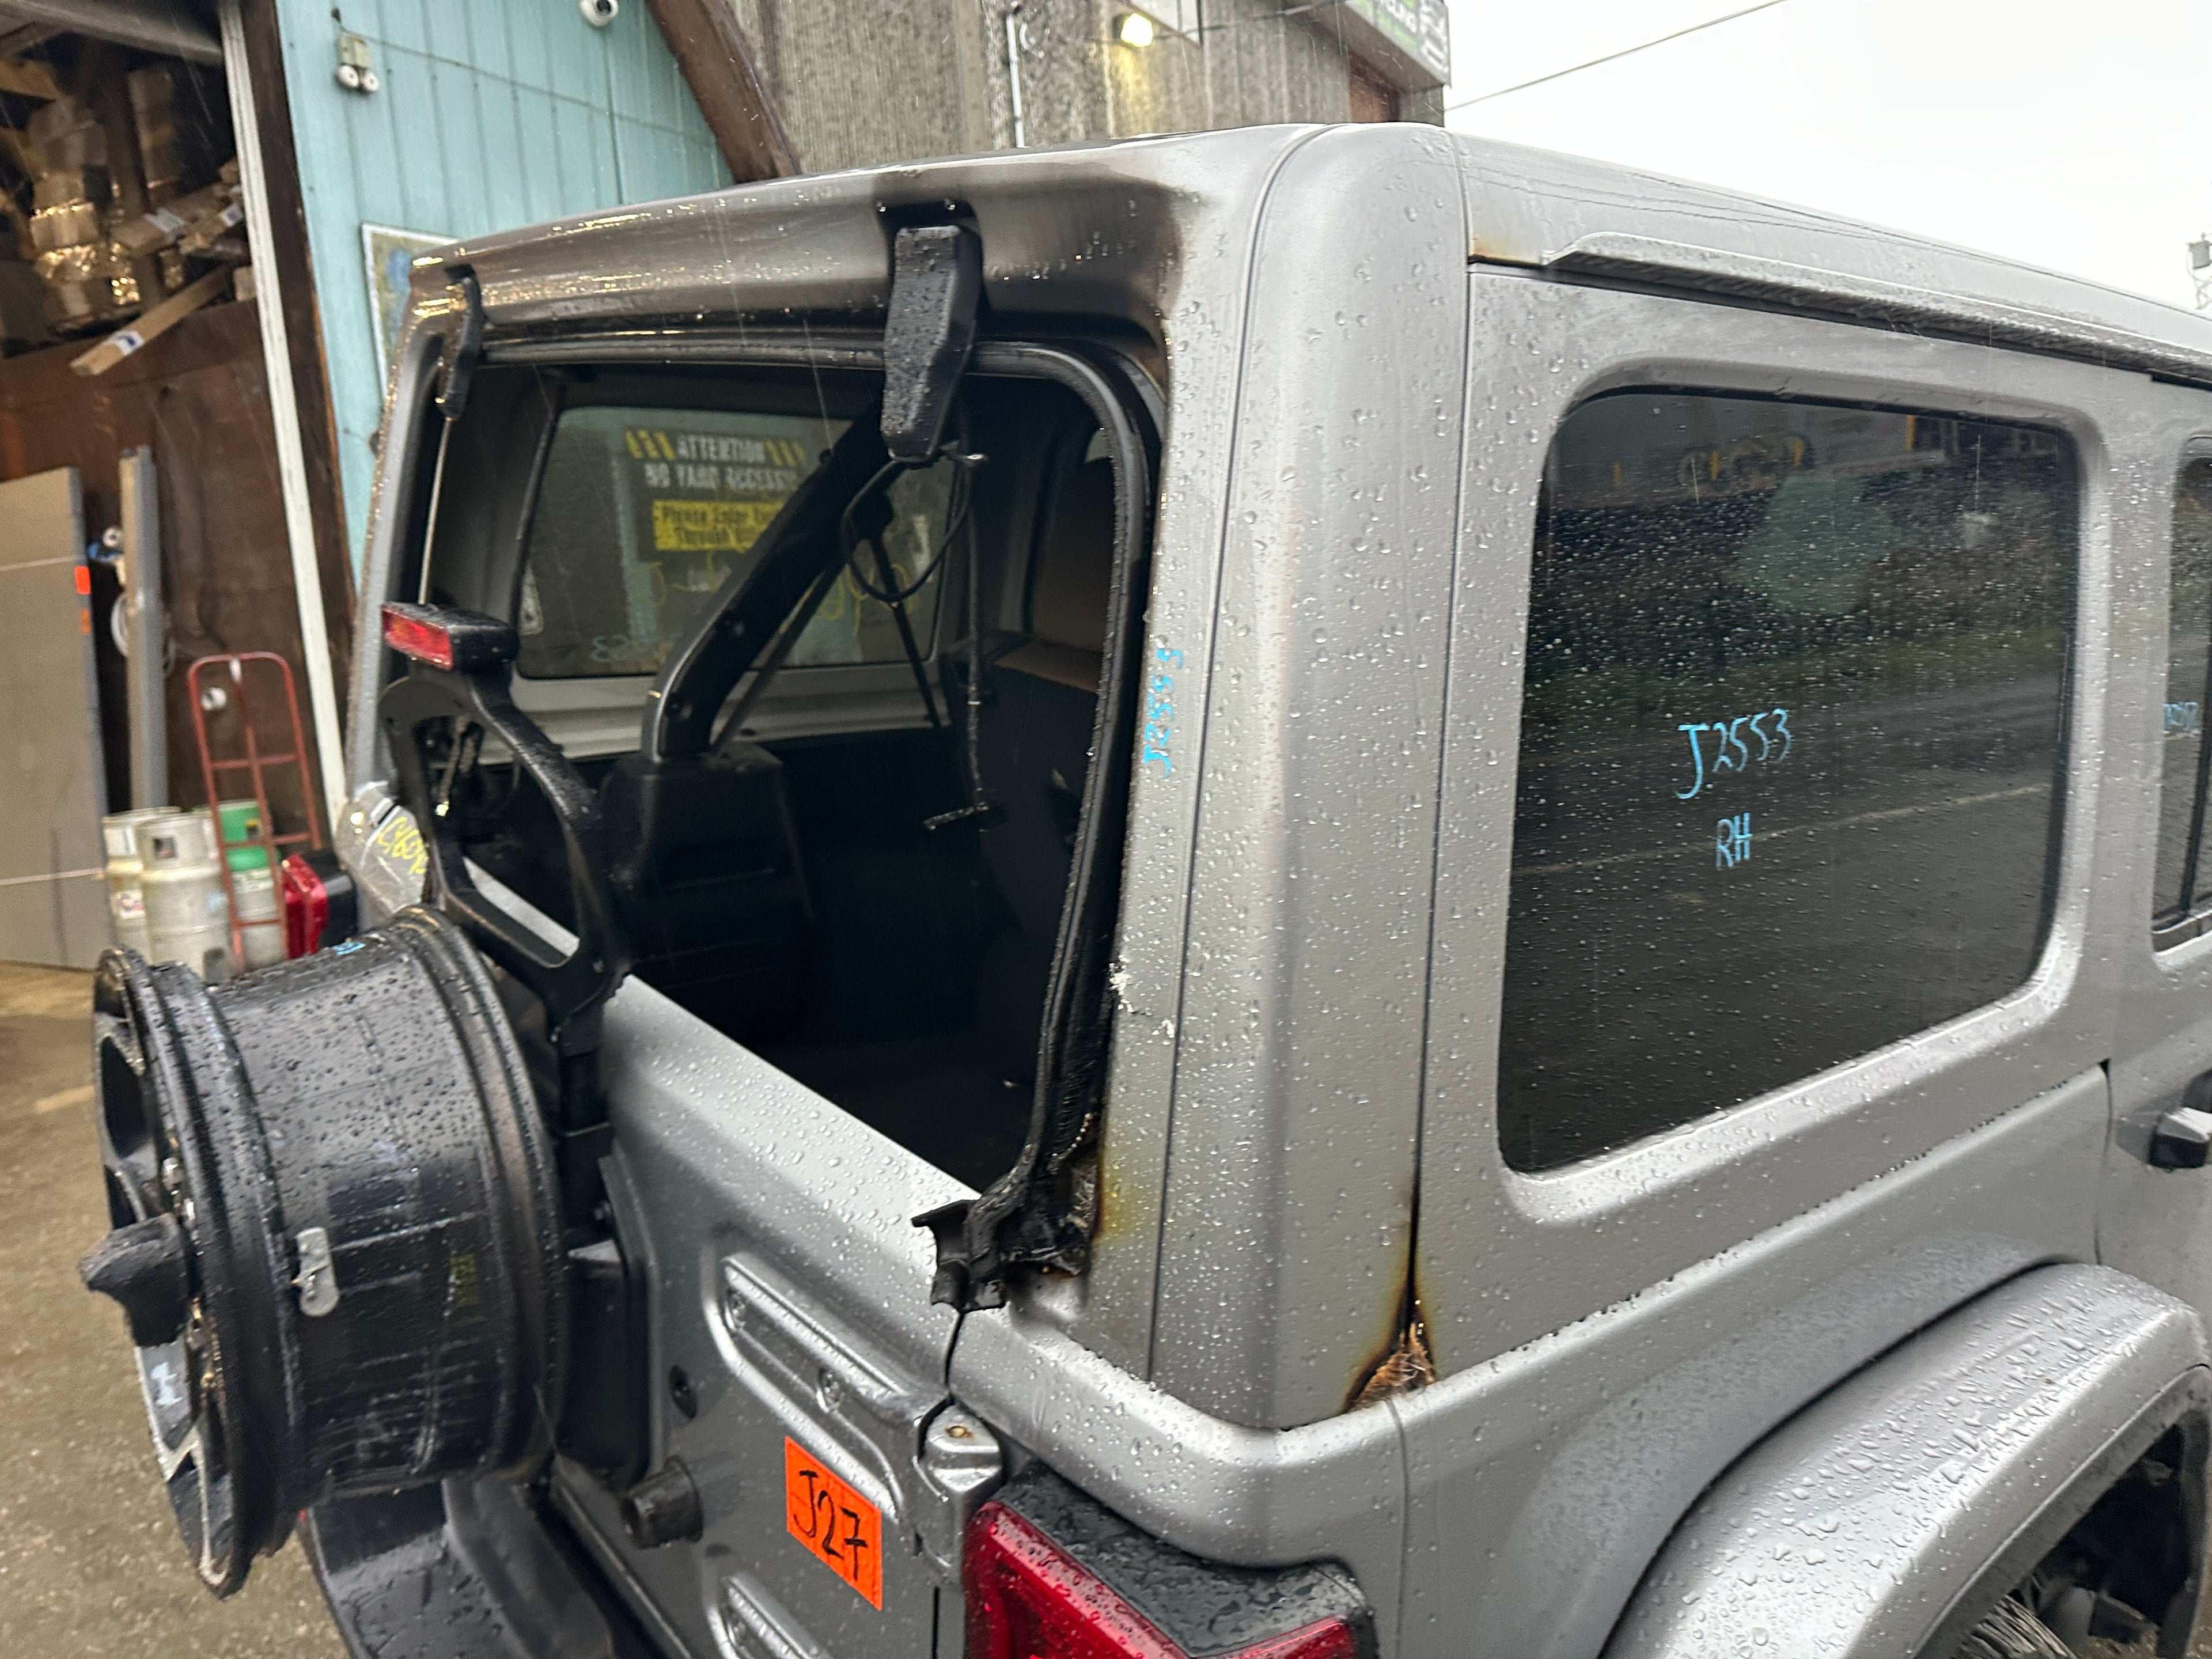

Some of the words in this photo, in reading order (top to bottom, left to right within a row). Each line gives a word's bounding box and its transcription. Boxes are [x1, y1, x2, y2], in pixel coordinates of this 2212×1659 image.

[676, 433, 766, 463] ATTENTION
[1673, 708, 1792, 800] J2553
[1716, 812, 1752, 869] RH
[793, 1469, 869, 1581] J27
